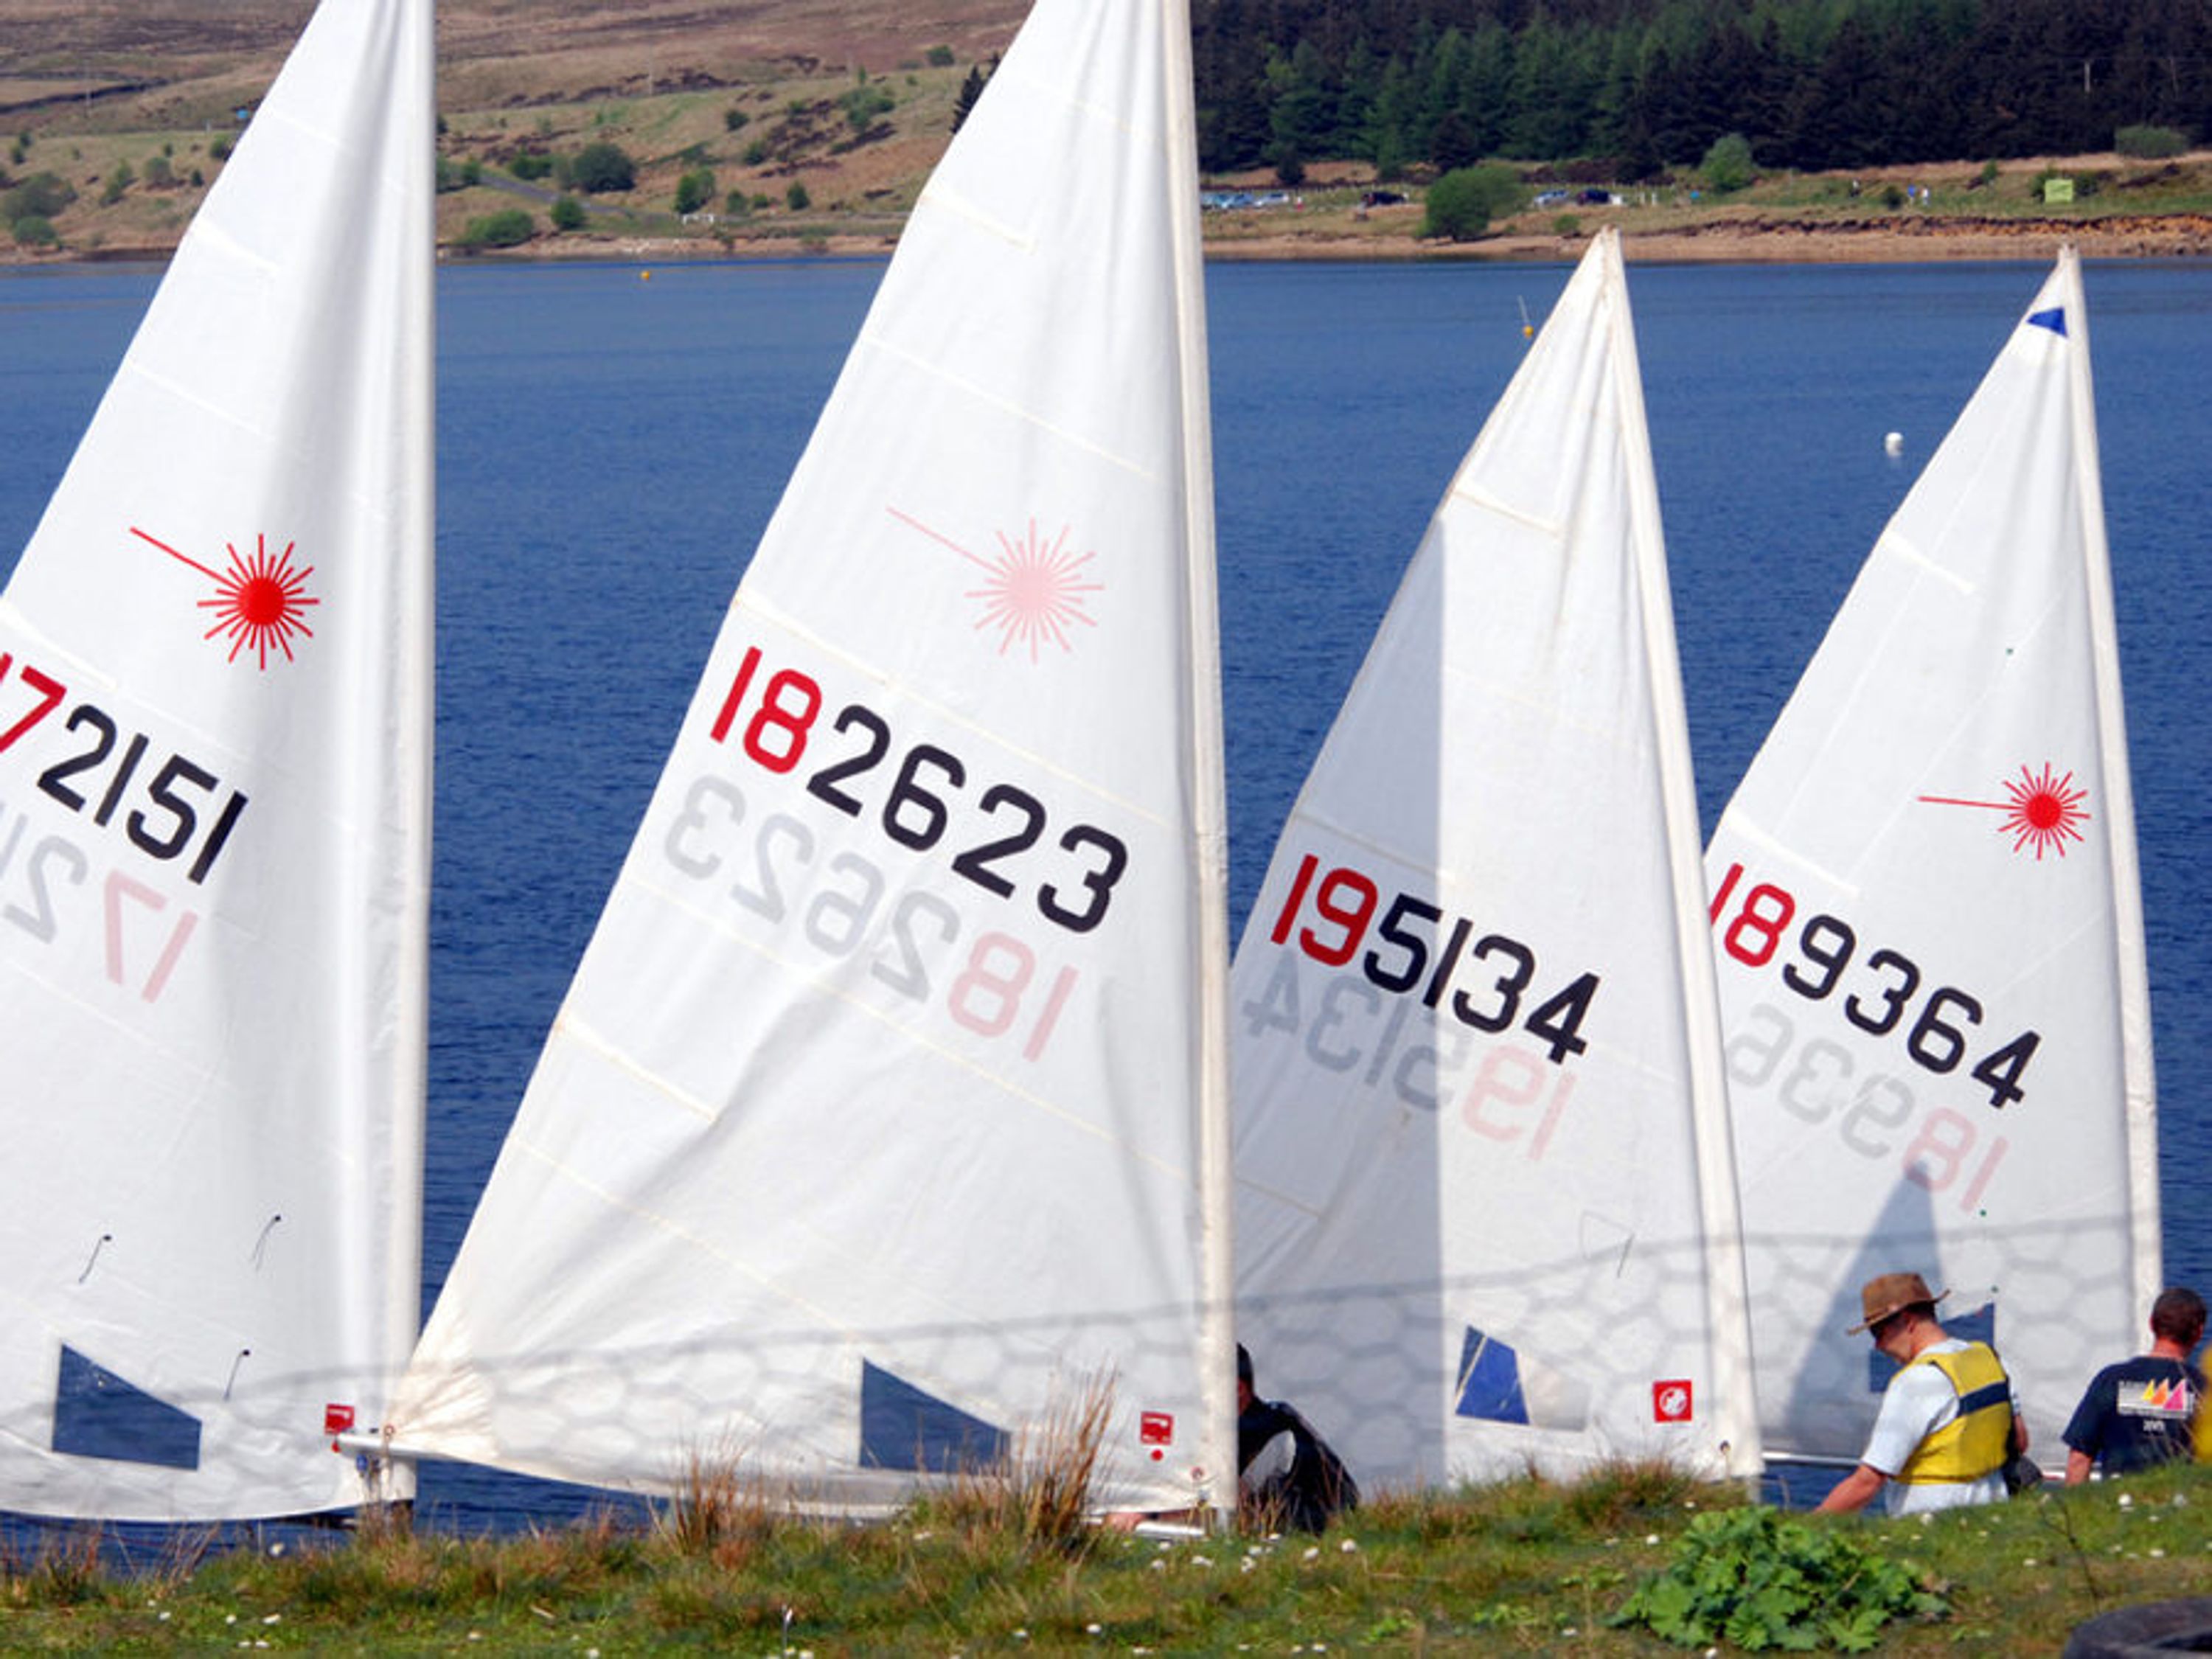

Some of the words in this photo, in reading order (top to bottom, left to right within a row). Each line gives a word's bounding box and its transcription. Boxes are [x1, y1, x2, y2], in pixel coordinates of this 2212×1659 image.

[711, 647, 1127, 933] 182623
[1271, 854, 1600, 1064] 195134
[1710, 863, 2040, 1109] 189364
